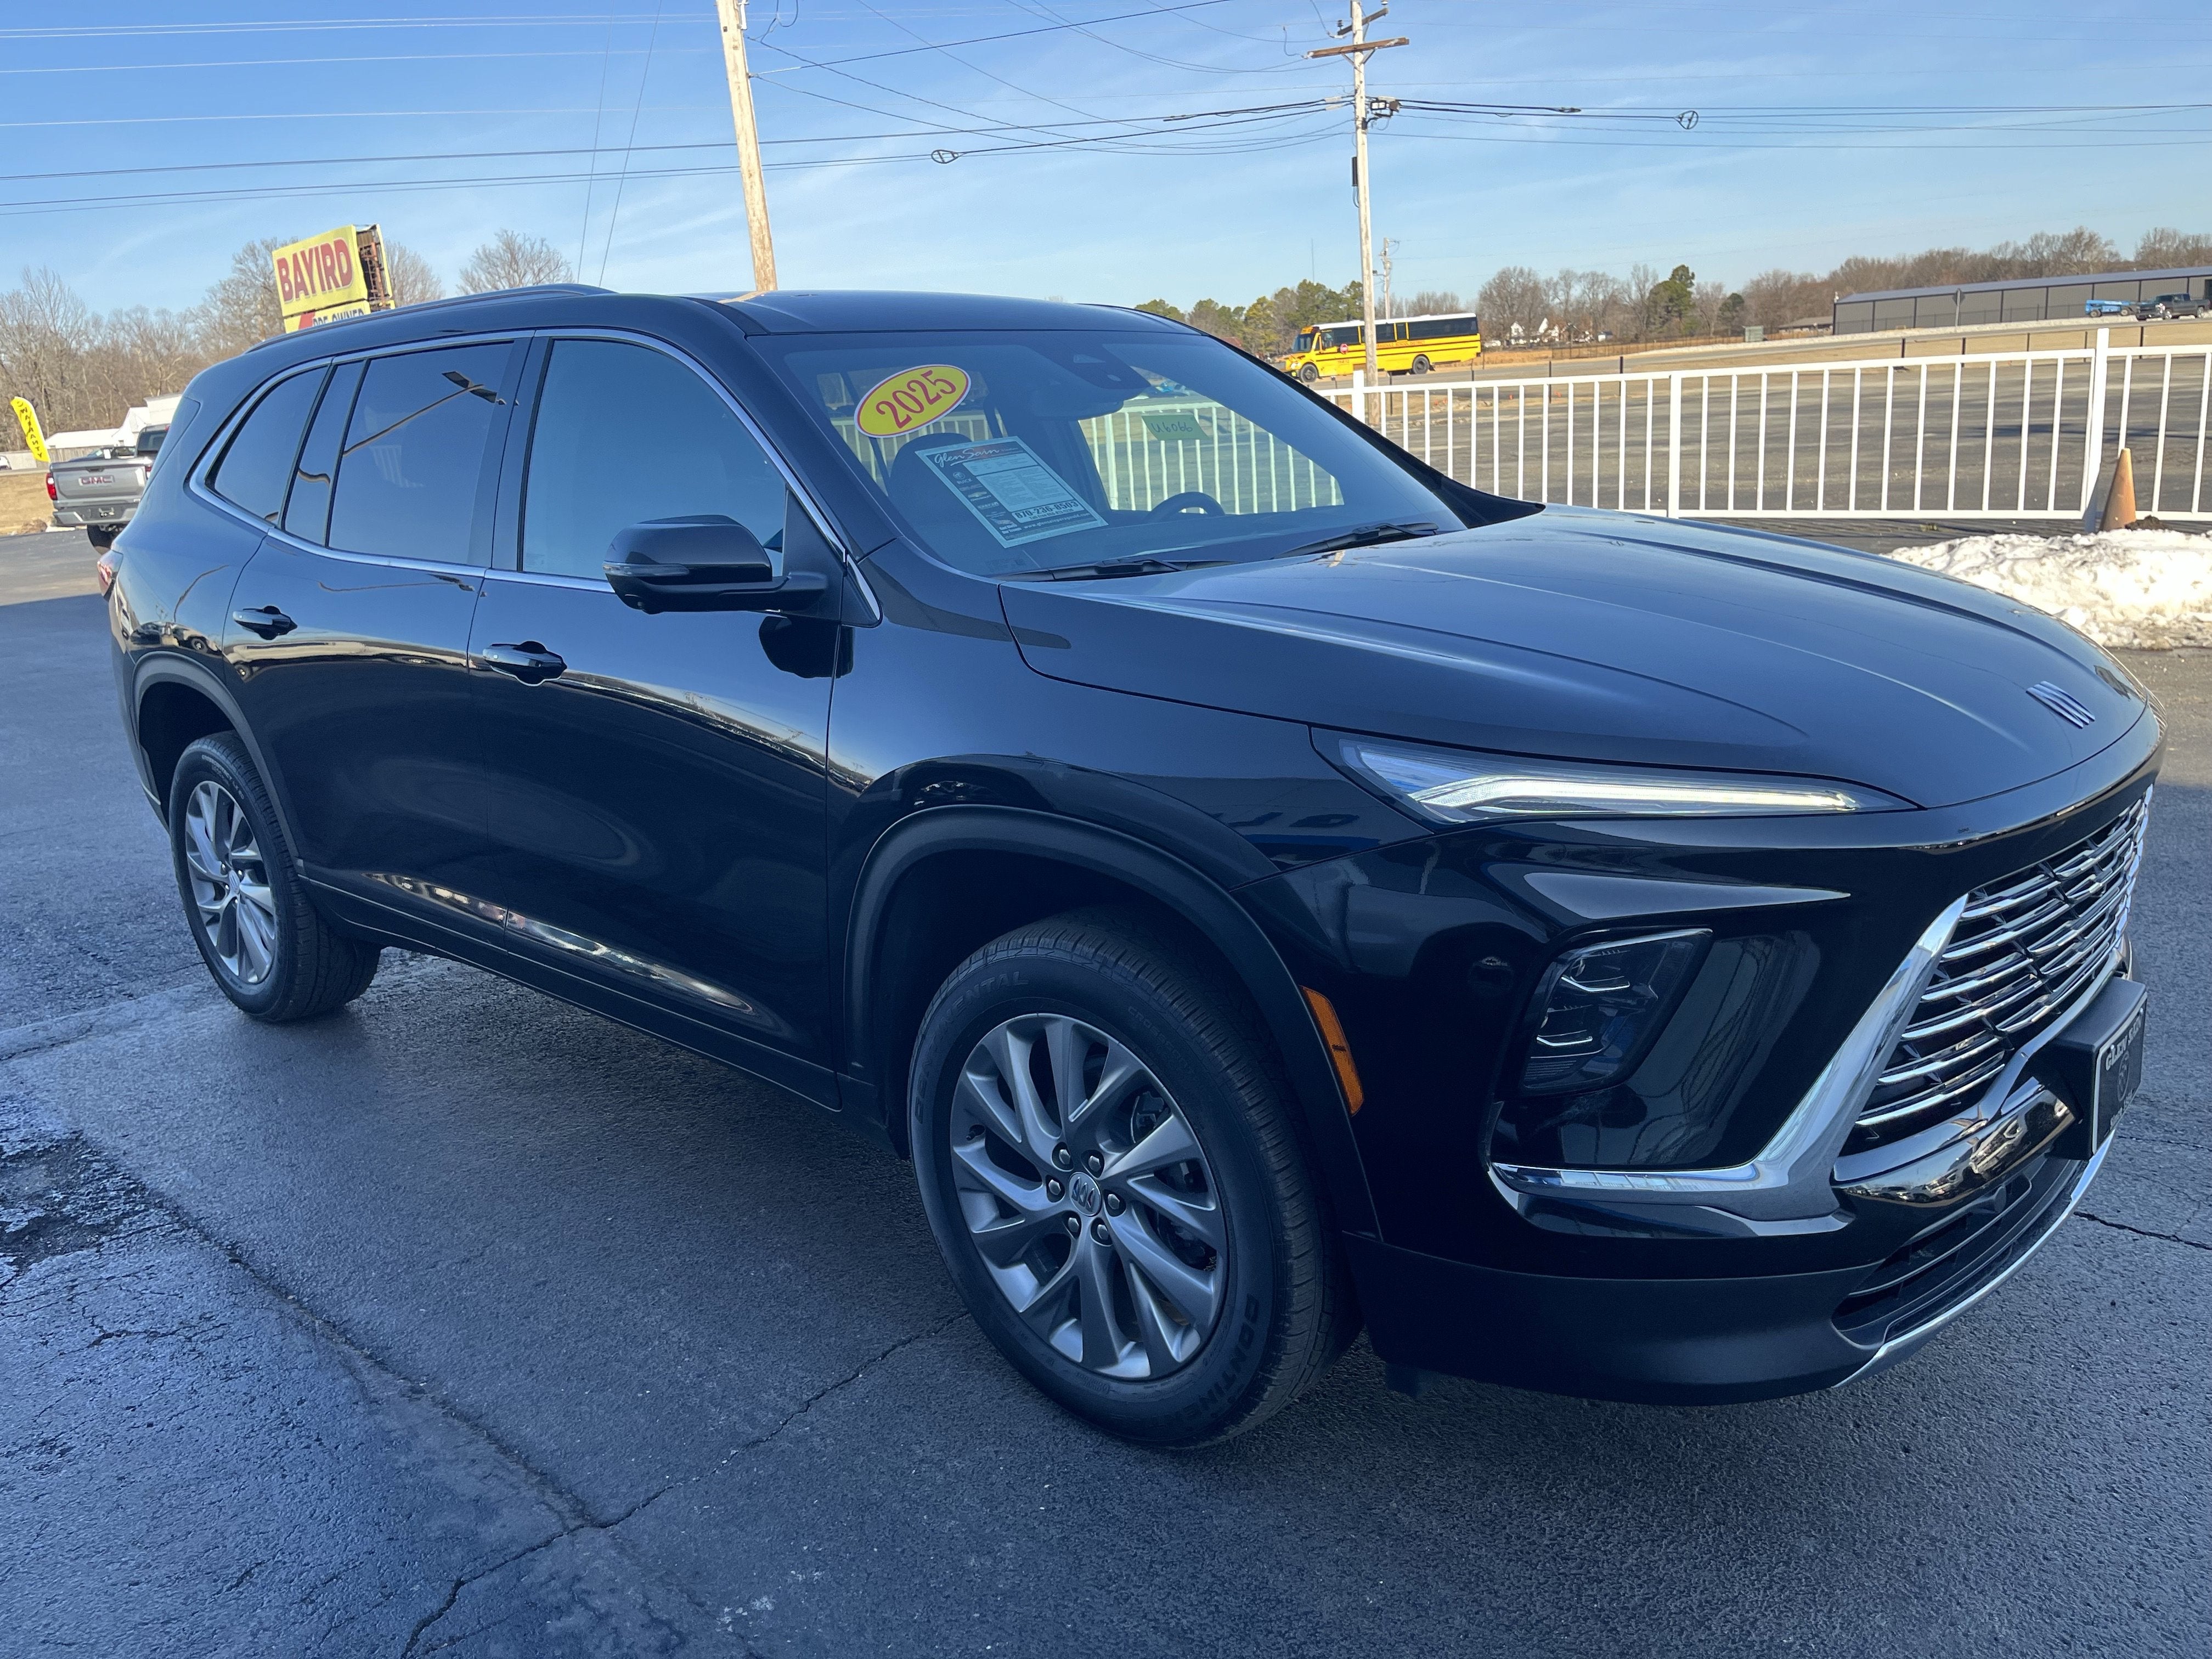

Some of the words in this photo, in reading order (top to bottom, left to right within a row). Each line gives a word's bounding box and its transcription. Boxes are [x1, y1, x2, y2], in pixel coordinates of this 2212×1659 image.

[277, 238, 353, 302] BAYIRD
[876, 370, 956, 428] 2025
[934, 453, 964, 468] Glen
[962, 448, 1011, 459] Sain
[81, 476, 113, 485] GMC
